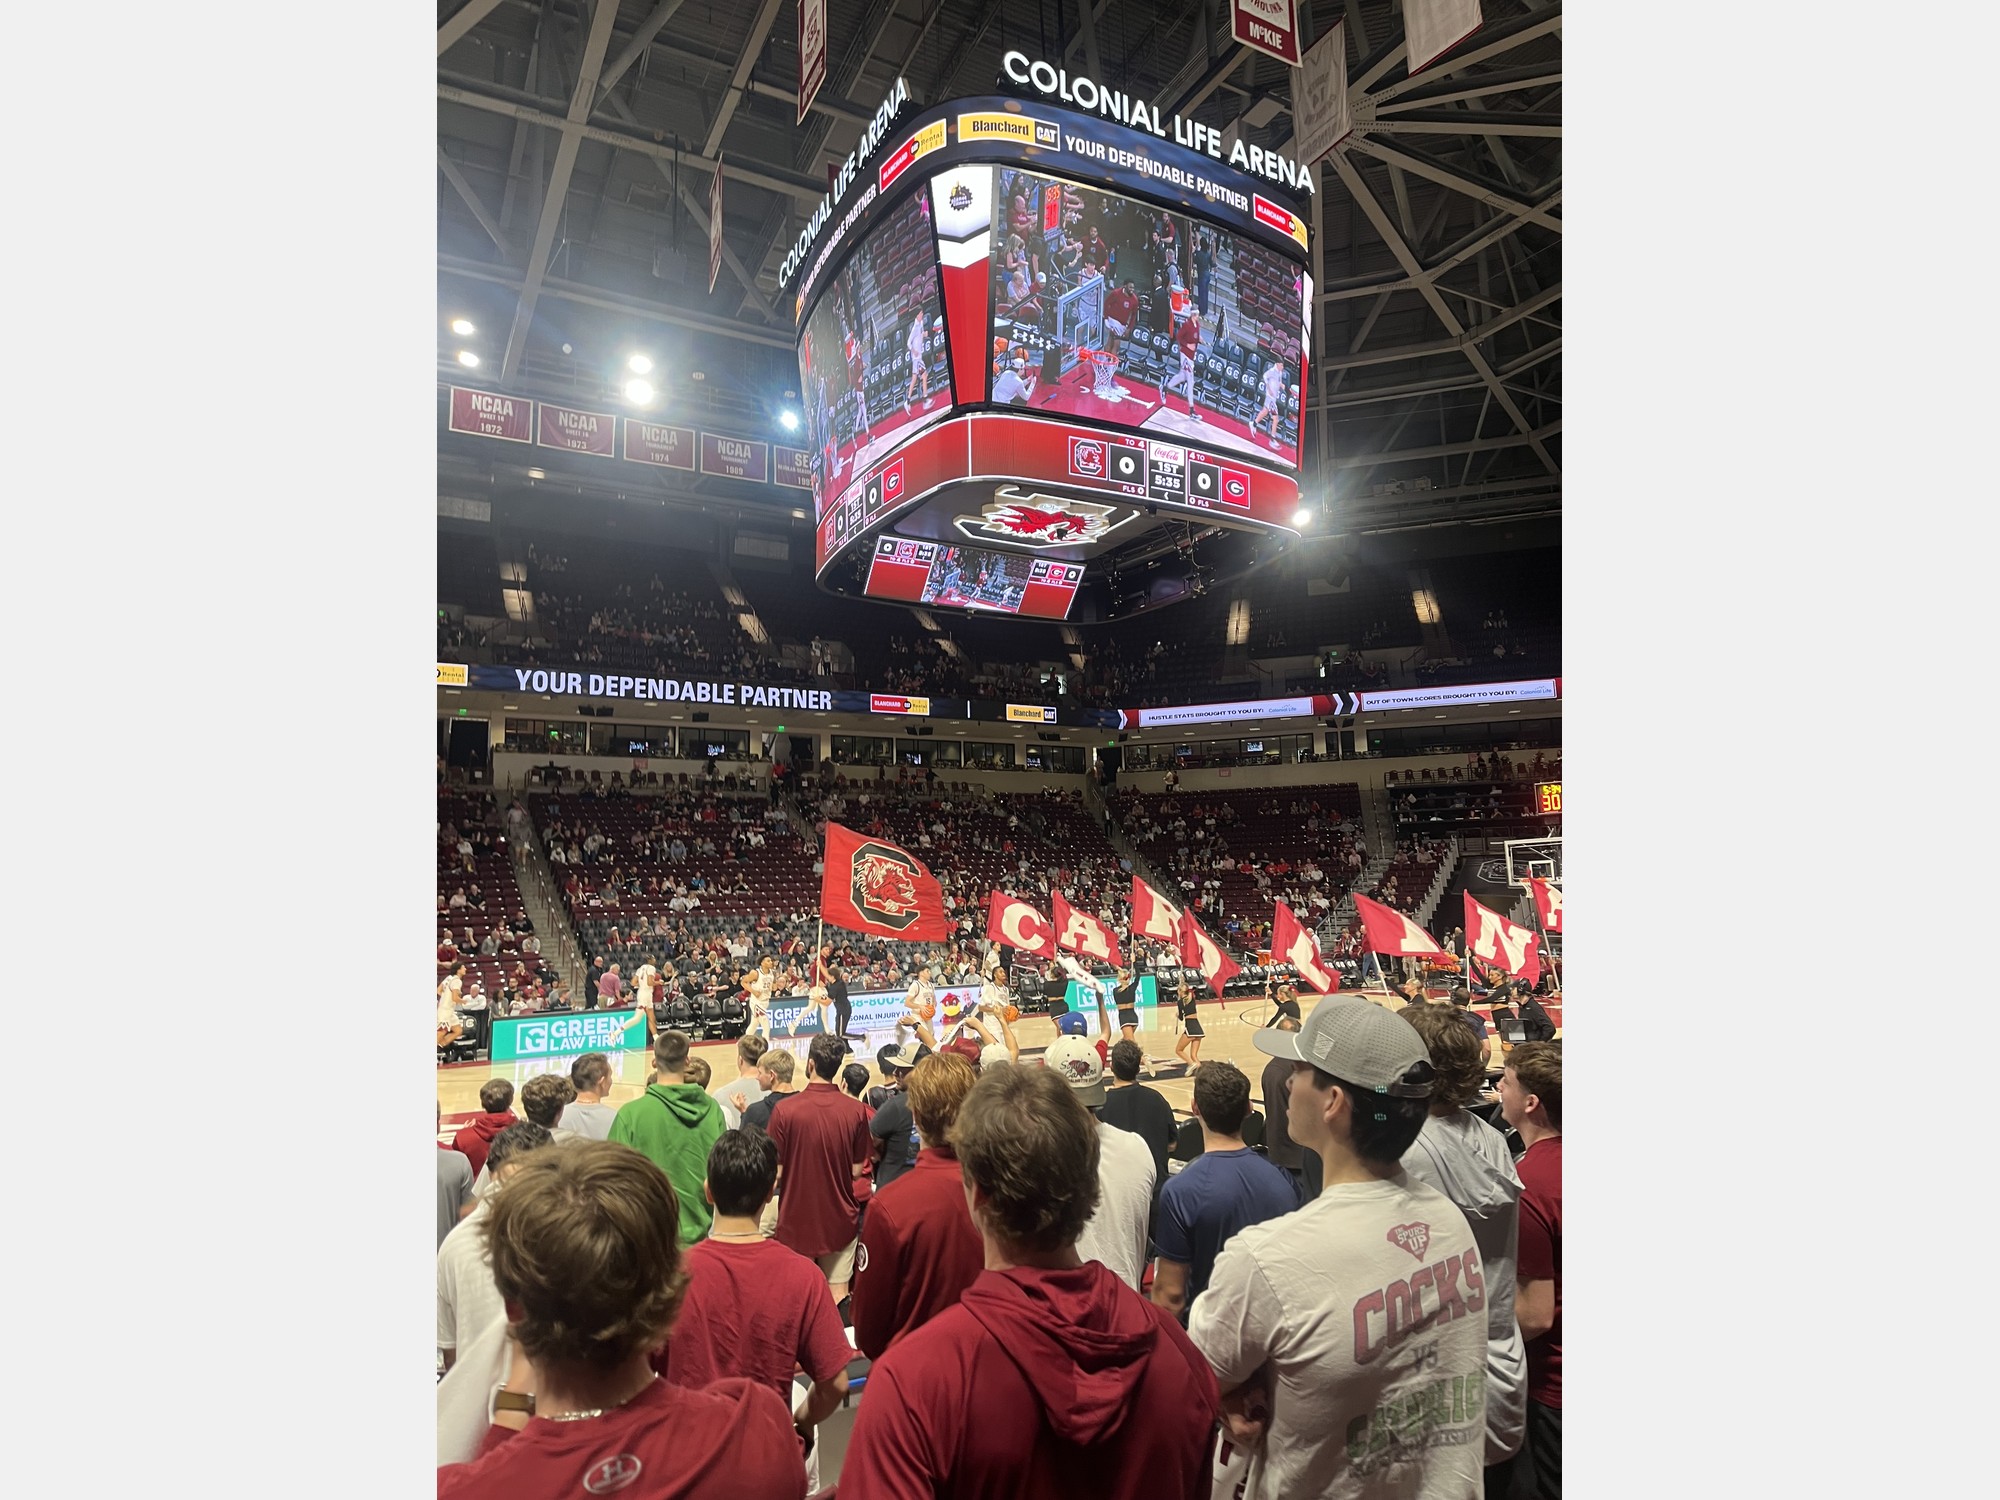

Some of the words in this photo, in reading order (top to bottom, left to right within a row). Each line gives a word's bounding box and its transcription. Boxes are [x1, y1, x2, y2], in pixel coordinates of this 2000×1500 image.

[1249, 21, 1283, 50] McKIE
[1003, 51, 1166, 137] COLONIAL
[1175, 114, 1221, 158] LIFE
[1230, 139, 1315, 193] ARENA
[921, 131, 943, 146] Rental
[972, 121, 1029, 136] Blanchard
[1036, 126, 1056, 143] CAT
[883, 152, 908, 180] BLANCHARD
[1065, 135, 1105, 160] YOUR
[1109, 149, 1195, 189] DEPENDABLE
[1197, 177, 1249, 211] PARTNER
[779, 192, 832, 288] COLONIAL
[834, 151, 856, 205] LIFE
[858, 76, 907, 168] ARENA
[1257, 204, 1286, 225] BLANCHARD
[814, 220, 846, 279] DEPENDABLE
[846, 183, 877, 230] PARTNER
[471, 394, 514, 417] NCAA
[480, 423, 503, 435] 1972
[559, 411, 598, 432] NCAA
[567, 438, 587, 450] 1973
[641, 426, 678, 446] NCAA
[1125, 438, 1135, 446] TO
[1138, 440, 1145, 448] 4
[651, 452, 669, 463] 1974
[717, 439, 752, 459] NCAA
[1189, 452, 1196, 460] 4
[1196, 453, 1205, 461] TO
[795, 453, 809, 468] SE
[1119, 456, 1135, 474] 0
[1158, 462, 1179, 474] 1ST
[798, 477, 811, 486] 199
[1122, 485, 1136, 493] FLS
[1154, 474, 1181, 489] 5:35
[1197, 472, 1211, 490] 0
[869, 487, 877, 504] 0
[1197, 499, 1209, 508] FLS
[837, 515, 843, 531] 0
[883, 543, 892, 552] 0
[1068, 570, 1076, 579] 0
[442, 671, 465, 679] Rental
[515, 668, 582, 695] YOUR
[589, 673, 735, 704] DEPENDABLE
[741, 685, 832, 710] PARTNER
[874, 699, 901, 708] BLANCHARD
[1013, 709, 1041, 718] Blanchard
[1044, 711, 1055, 719] CAT
[1542, 794, 1561, 811] 30
[1001, 903, 1046, 950] C
[1060, 909, 1110, 959] A
[1474, 903, 1532, 975] N
[875, 1011, 900, 1019] INJURY
[551, 1016, 625, 1037] GREEN
[550, 1036, 586, 1051] LAW
[589, 1033, 624, 1048] FIRM
[1397, 1225, 1426, 1244] SPURS
[1408, 1234, 1427, 1251] UP
[1353, 1246, 1485, 1366] COCKS
